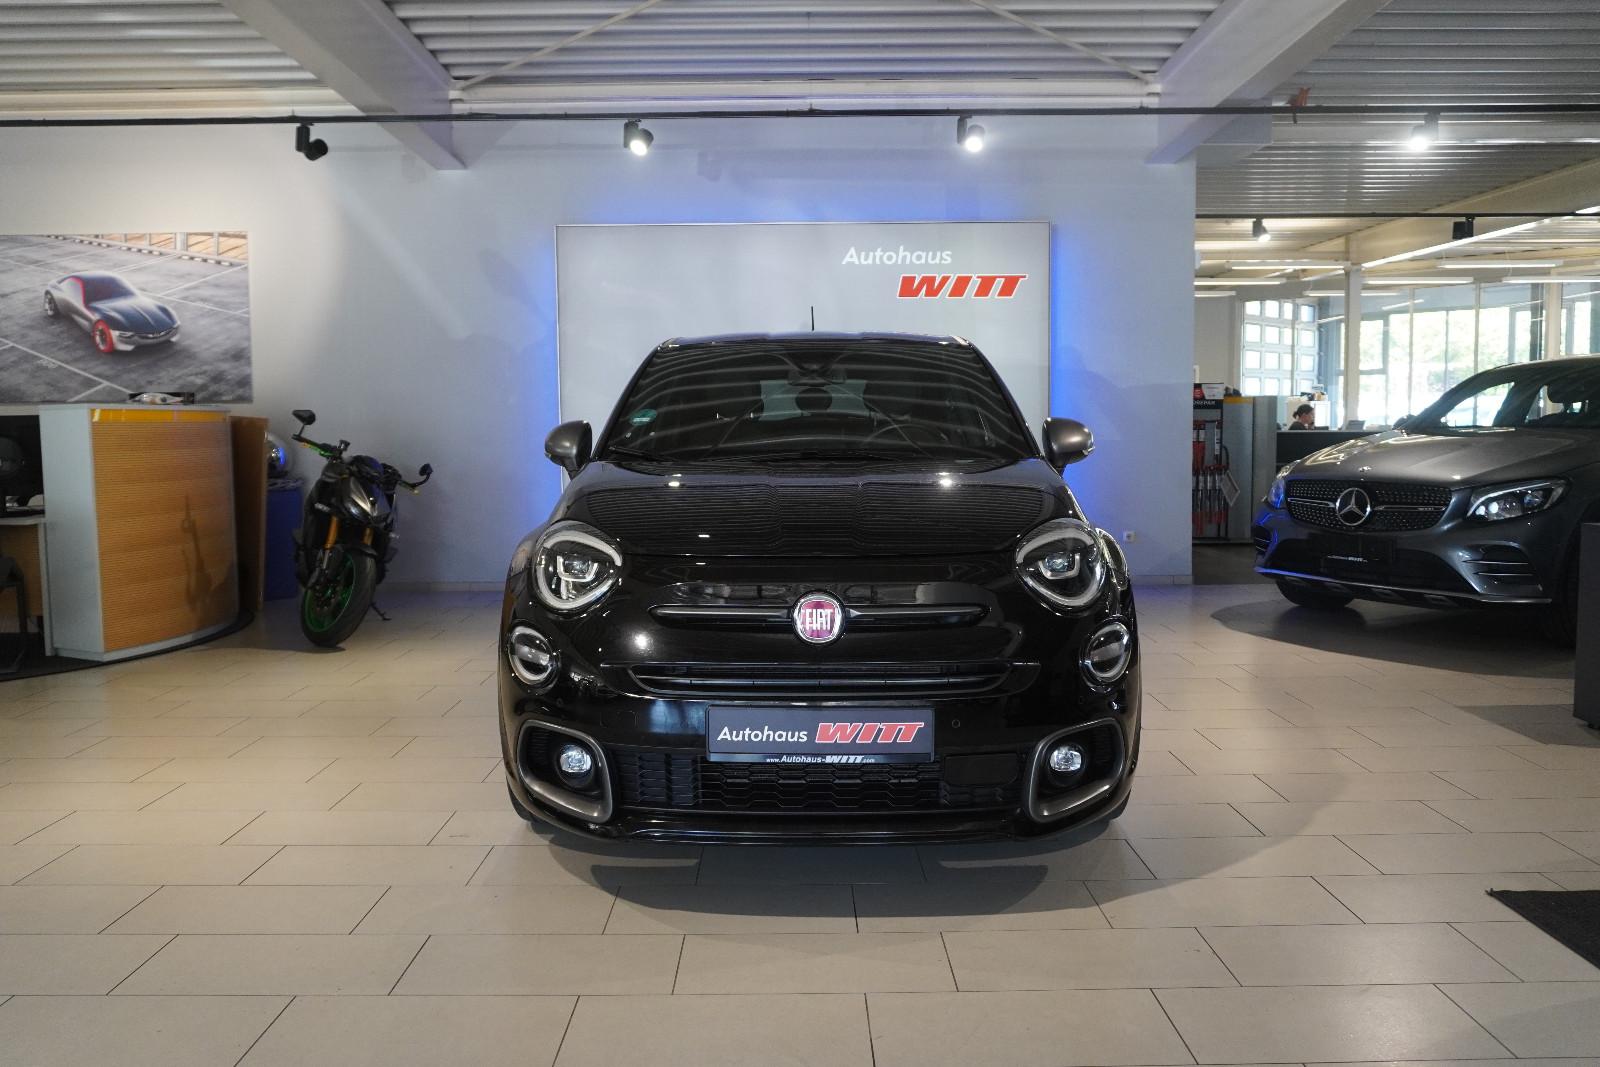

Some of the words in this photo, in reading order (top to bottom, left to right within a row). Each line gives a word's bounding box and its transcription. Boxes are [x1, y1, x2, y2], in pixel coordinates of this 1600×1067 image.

[842, 246, 952, 265] Autohaus
[897, 273, 1028, 299] WITT
[805, 608, 834, 630] FIAT
[716, 726, 808, 742] Autohaus
[815, 722, 924, 743] WITT
